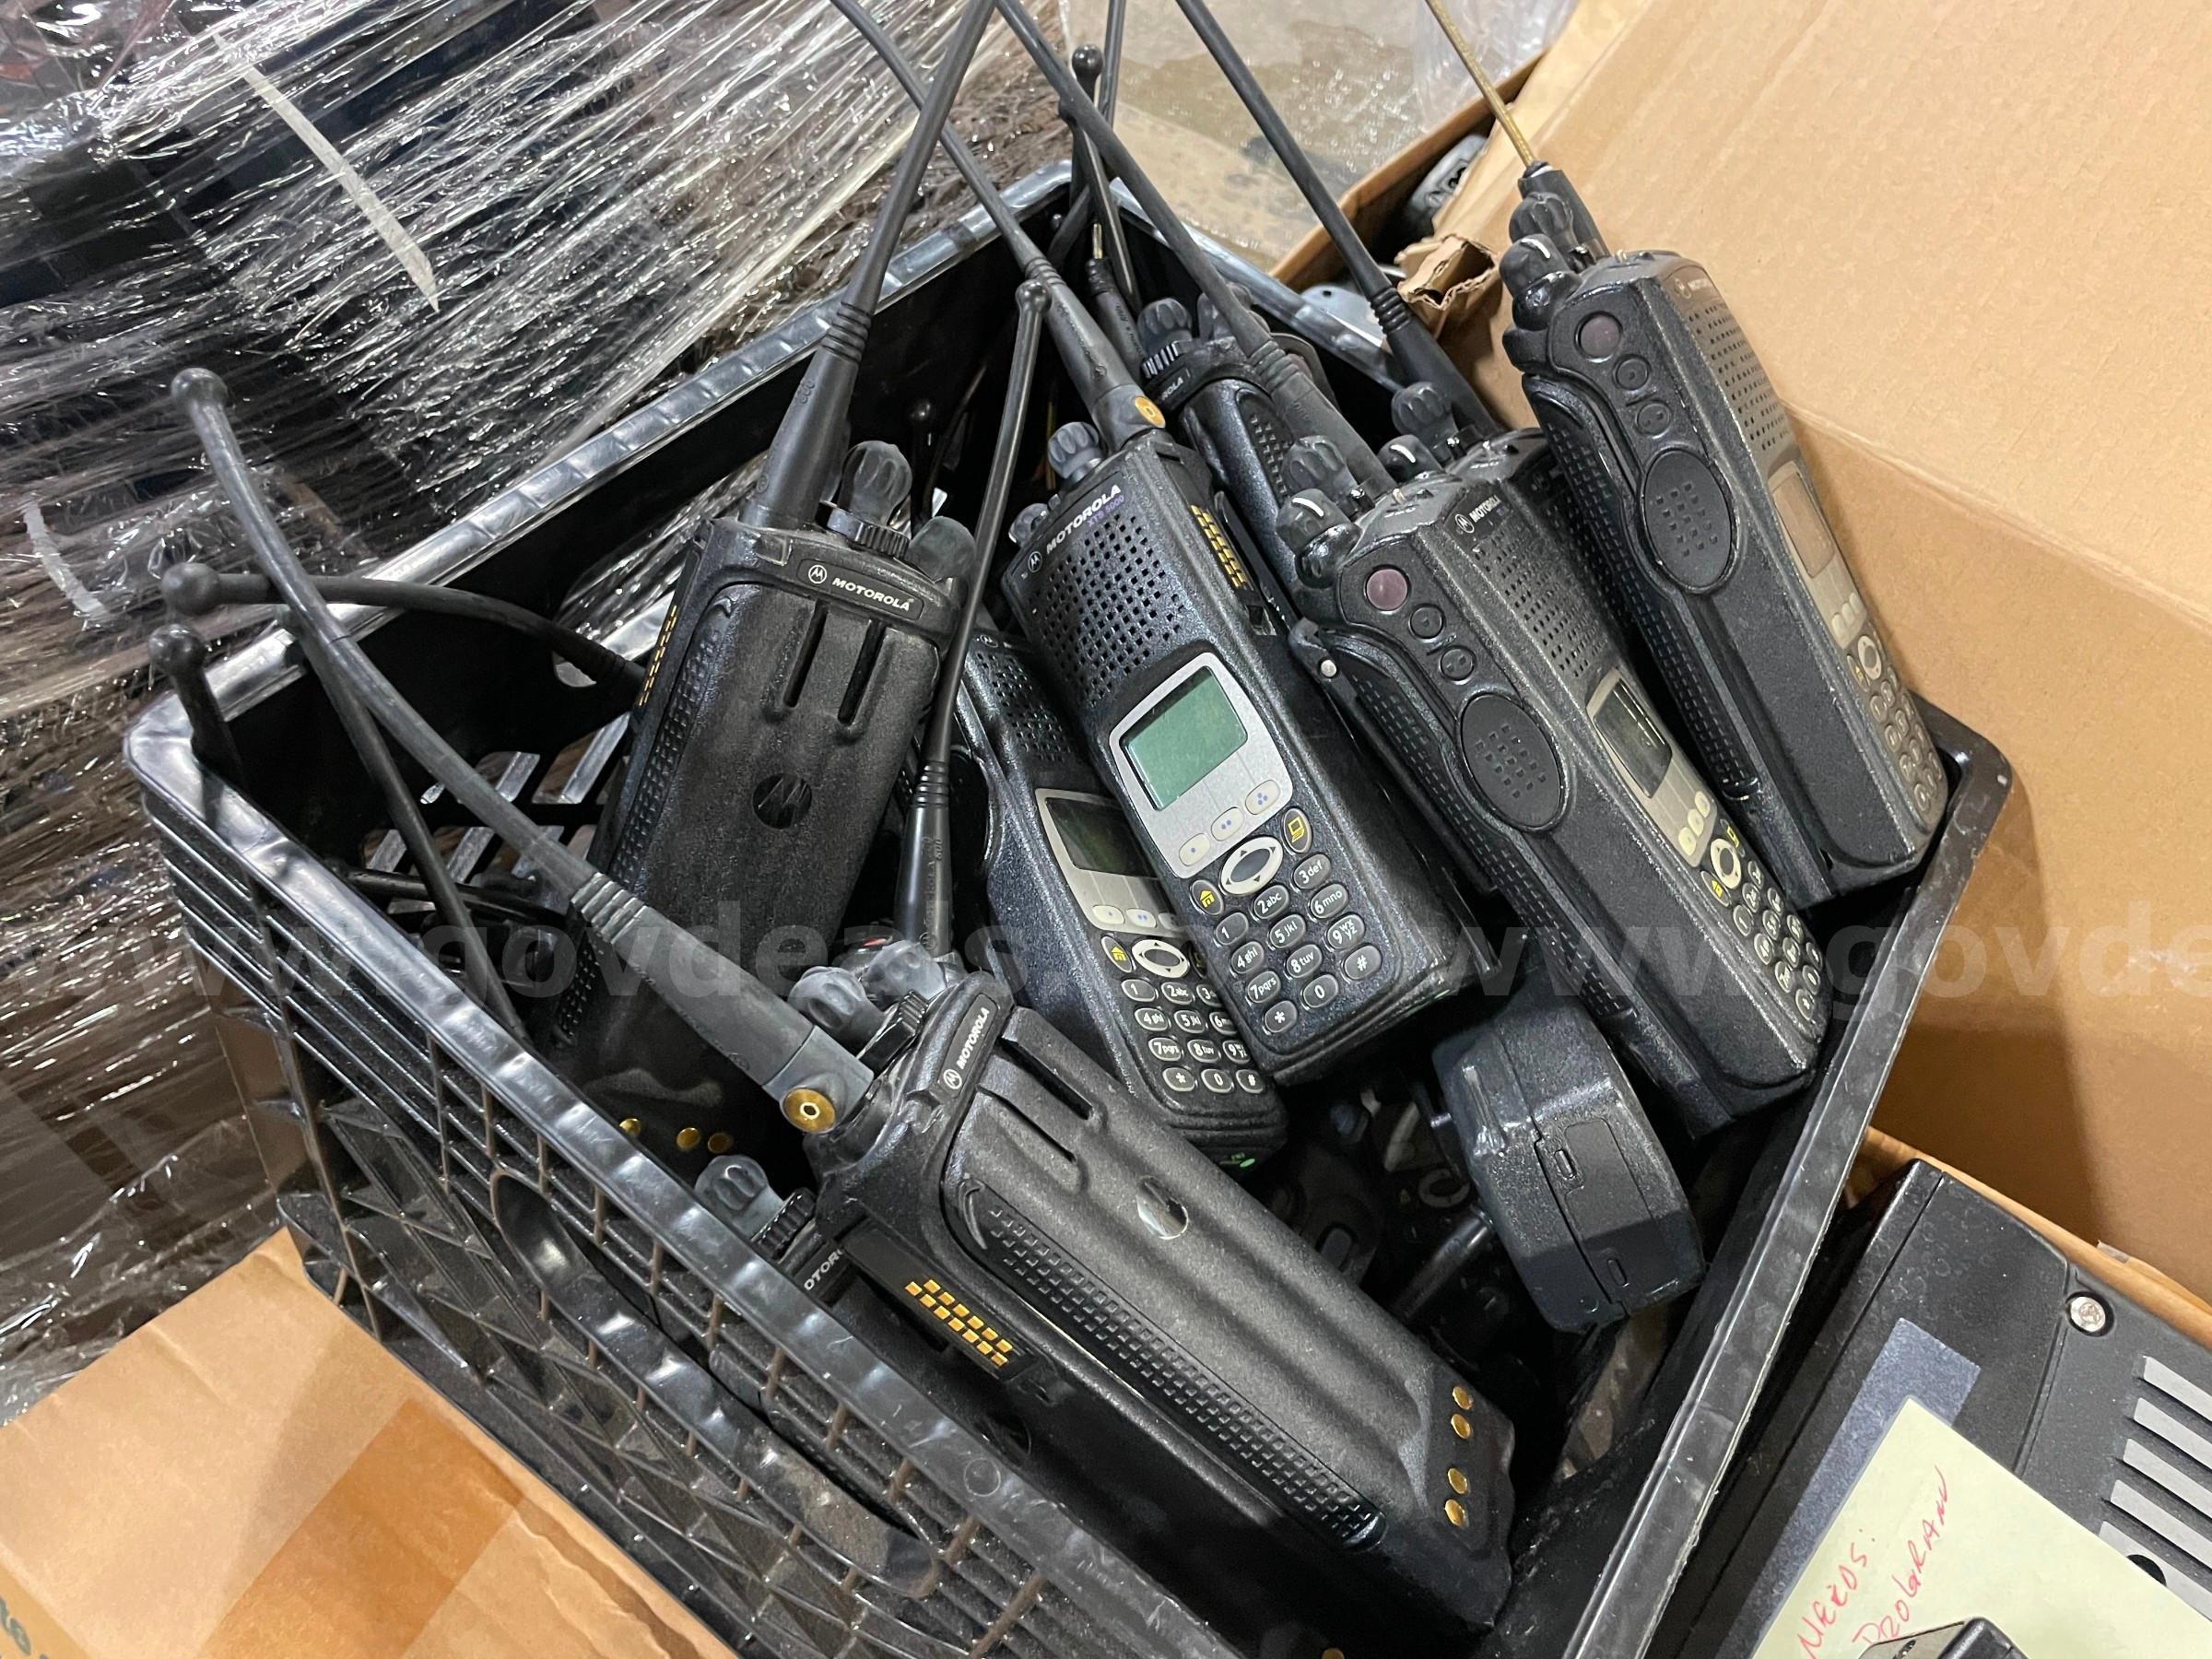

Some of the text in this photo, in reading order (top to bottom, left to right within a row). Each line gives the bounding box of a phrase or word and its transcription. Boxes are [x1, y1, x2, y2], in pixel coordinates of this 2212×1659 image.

[1046, 484, 1122, 554] MOTOROLA
[831, 577, 911, 612] MOTOROLA
[956, 1006, 990, 1070] MOTOROLA
